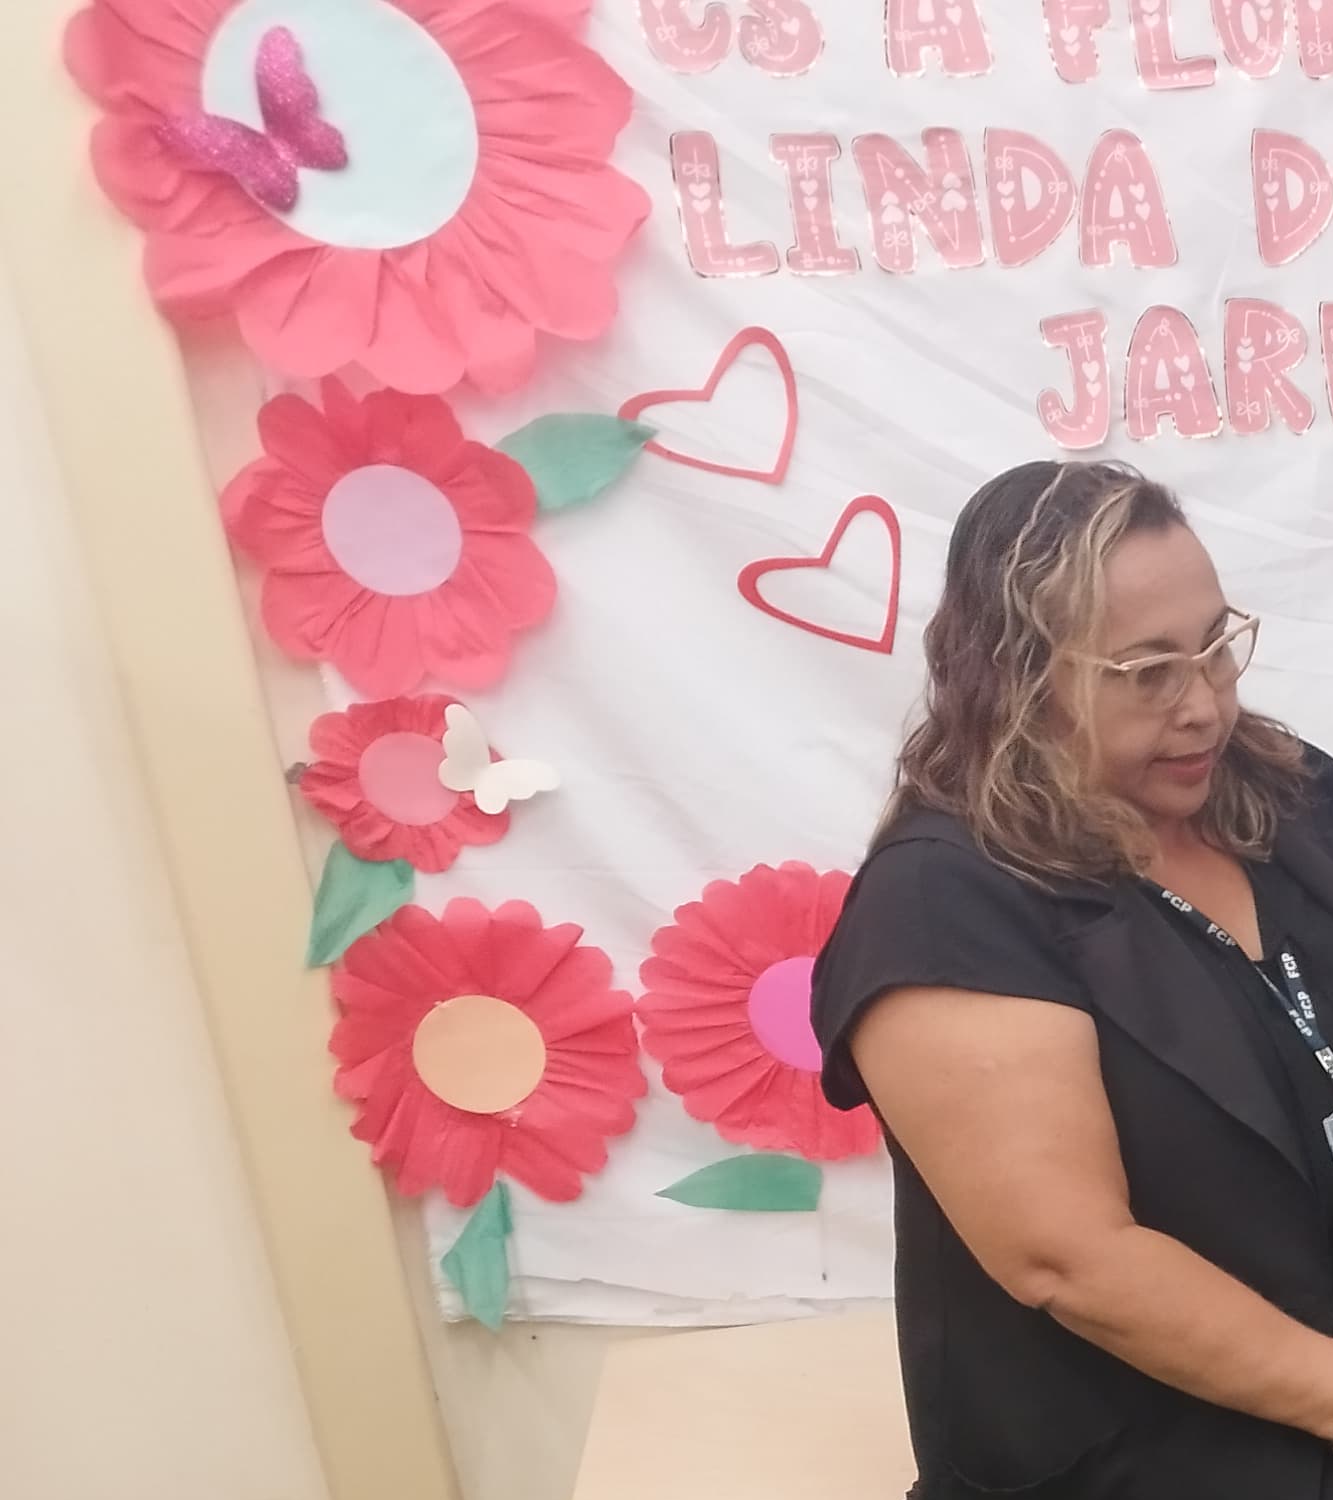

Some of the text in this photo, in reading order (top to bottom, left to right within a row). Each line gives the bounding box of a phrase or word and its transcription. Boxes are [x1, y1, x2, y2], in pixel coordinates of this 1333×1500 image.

[882, 0, 996, 78] A
[668, 126, 1180, 279] LINDA
[1161, 889, 1193, 914] FCP
[1281, 951, 1299, 980] FCP
[1297, 990, 1317, 1020] FCP
